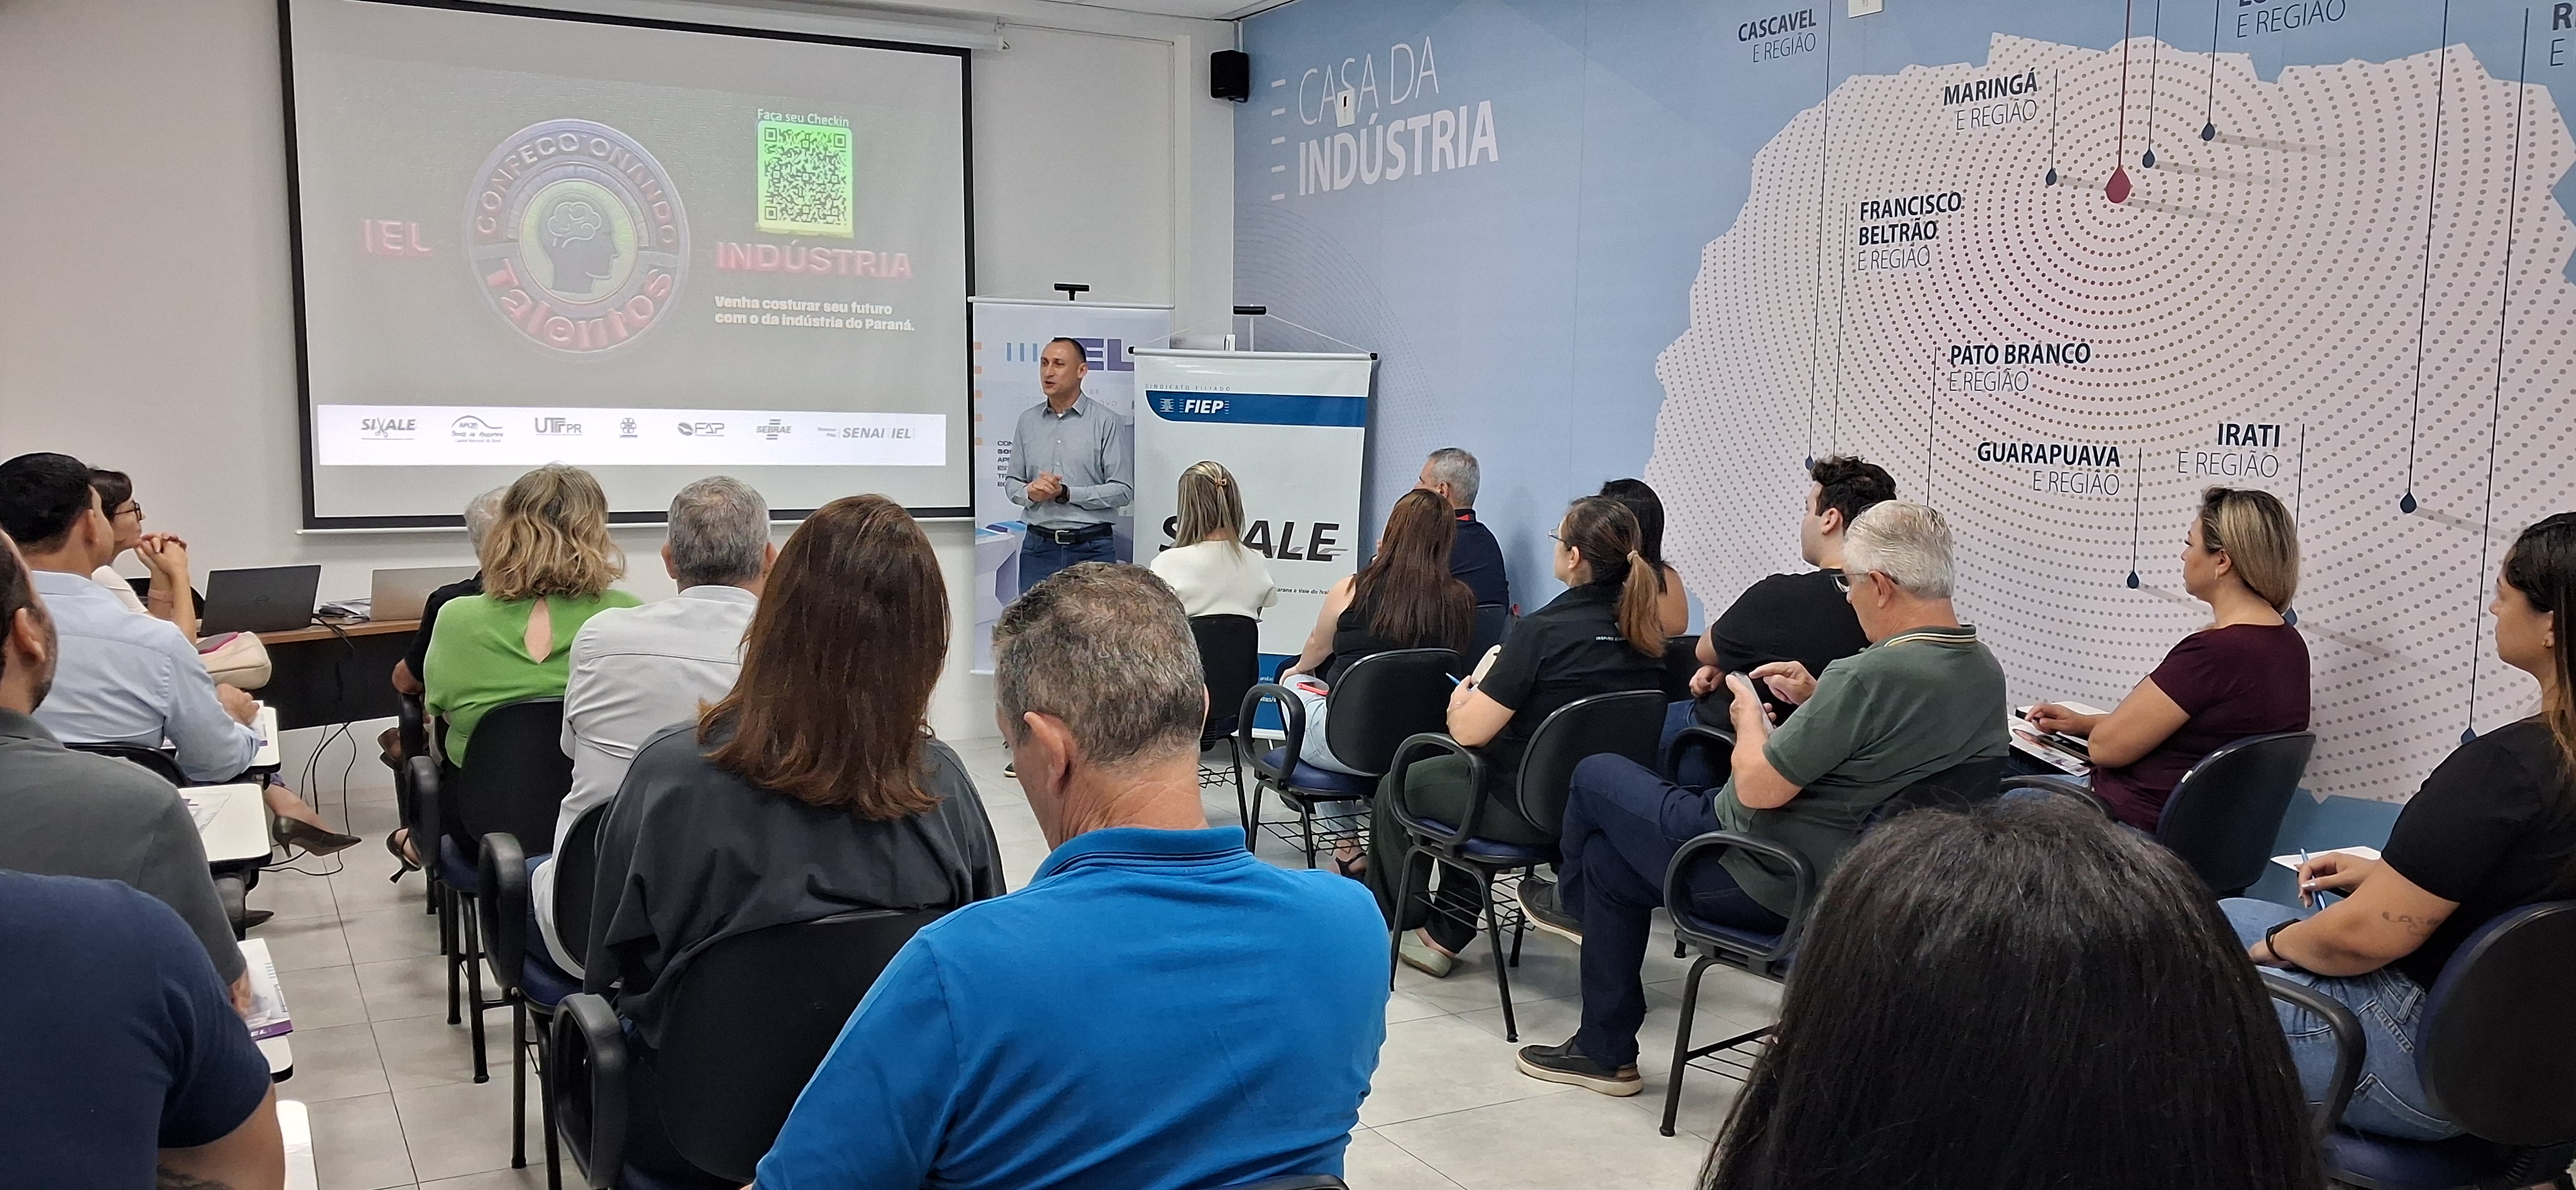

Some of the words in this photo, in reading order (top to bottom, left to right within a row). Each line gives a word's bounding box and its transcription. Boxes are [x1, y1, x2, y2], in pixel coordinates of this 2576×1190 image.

[1738, 8, 1817, 42] CASCAVEL
[2237, 13, 2249, 38] E
[1753, 44, 1760, 63] E
[1764, 32, 1816, 61] REGIÃO
[1298, 53, 1380, 126] CASA
[1390, 35, 1439, 105] DA
[1943, 66, 2038, 106] MARINGÁ
[757, 108, 782, 122] Faça
[785, 113, 804, 123] seu
[807, 113, 849, 128] Checkin
[1956, 109, 1965, 131] E
[1971, 98, 2037, 129] REGIÃO
[1299, 100, 1499, 196] INDÚSTRIA
[1859, 191, 1962, 221] FRANCISCO
[360, 219, 433, 256] IEL
[1858, 217, 1938, 246] BELTRÃO
[715, 239, 914, 279] INDÚSTRIA
[1857, 251, 1866, 271] E
[1870, 244, 1930, 270] REGIÃO
[714, 296, 760, 309] Venha
[761, 299, 820, 312] costurar
[823, 301, 848, 313] seu
[850, 301, 893, 315] futuro
[714, 313, 747, 324] com
[749, 314, 759, 325] o
[761, 313, 780, 326] da
[782, 313, 844, 328] indústria
[845, 317, 863, 329] do
[864, 318, 915, 332] Paraná.
[1073, 338, 1135, 371] EL
[1950, 344, 1999, 365] PATO
[2004, 342, 2091, 364] BRANCO
[1948, 371, 1959, 392] E
[1963, 368, 2029, 392] REGIÃO
[1184, 399, 1225, 414] FIEP
[756, 426, 792, 434] SEBRAE
[842, 427, 885, 439] SENAI
[891, 428, 912, 439] IEL
[2217, 423, 2281, 448] IRATI
[1977, 442, 2121, 468] GUARAPUAVA
[2178, 451, 2189, 474] E
[2195, 449, 2279, 478] REGIÃO
[2032, 470, 2042, 491] E
[2048, 468, 2120, 496] REGIÃO
[1158, 515, 1340, 562] SALE
